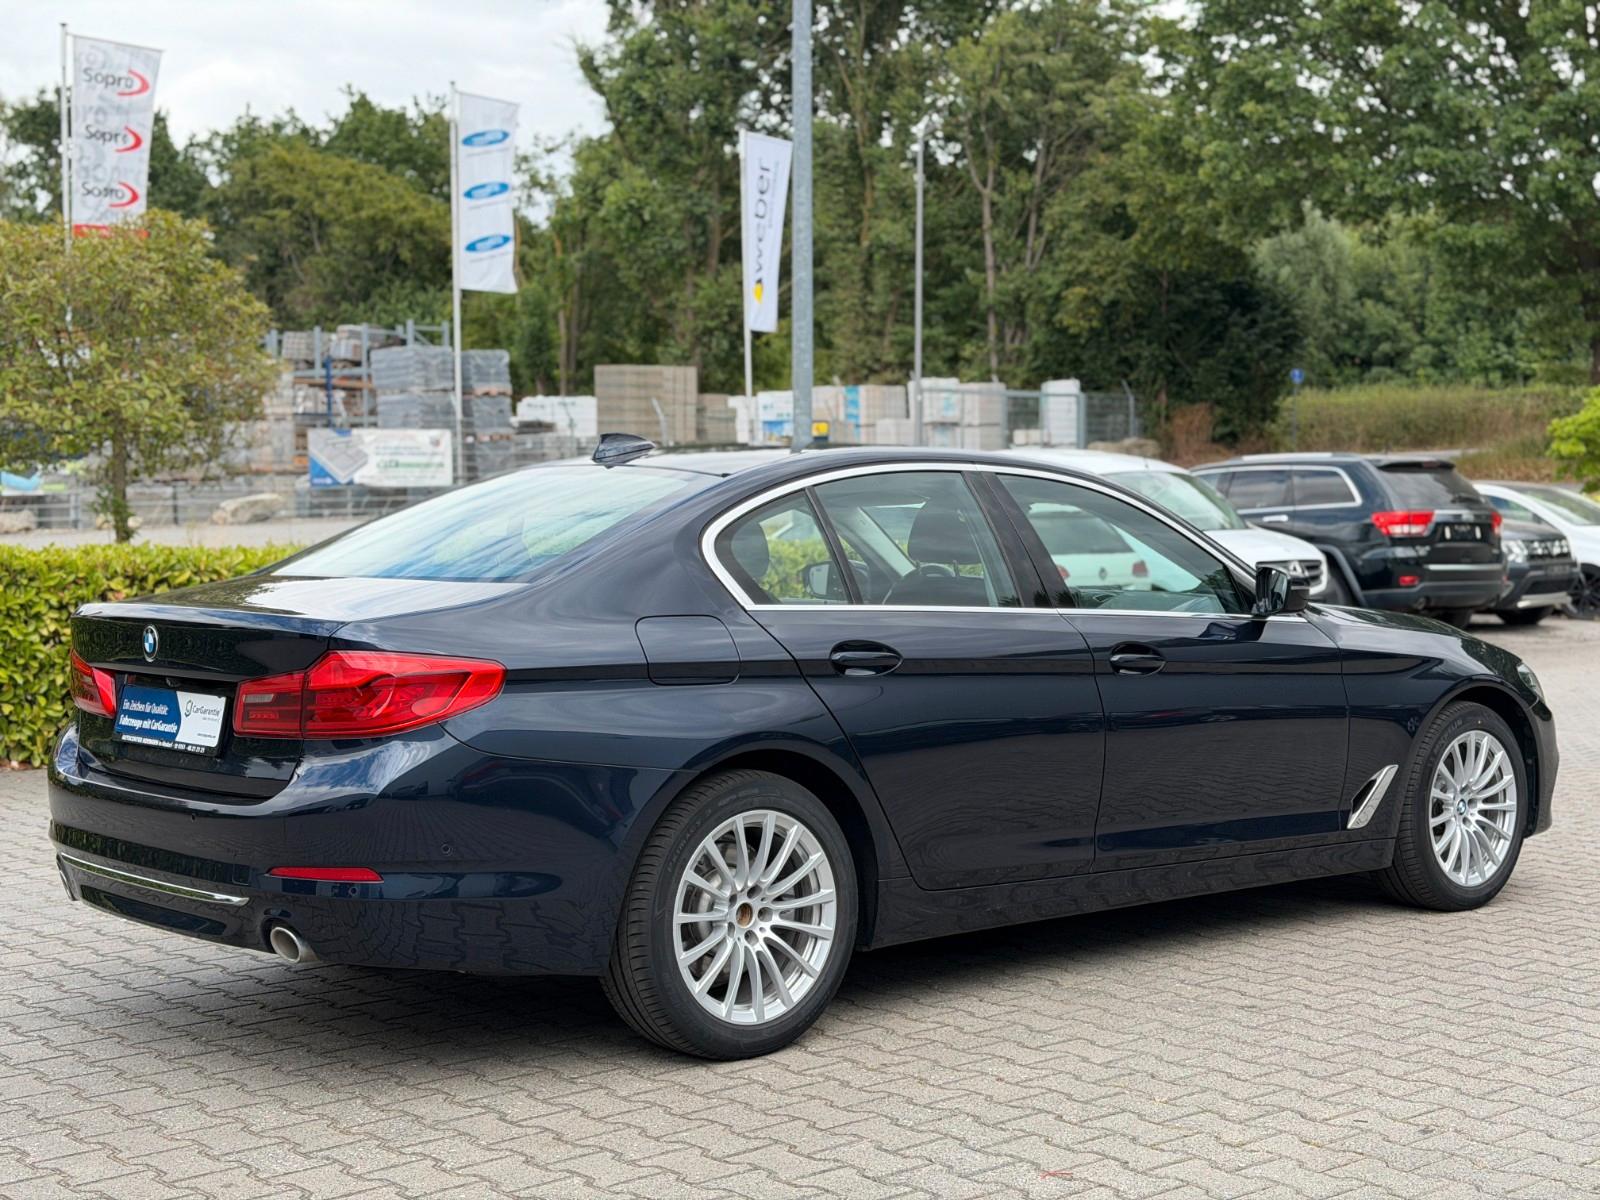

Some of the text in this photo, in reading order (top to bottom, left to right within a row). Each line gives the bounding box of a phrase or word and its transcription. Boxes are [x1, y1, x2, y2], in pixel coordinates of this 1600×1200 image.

[82, 66, 134, 89] Sopro
[193, 706, 220, 717] CarGarantie
[119, 715, 178, 733] Fahrzeuge mit CarGarantie
